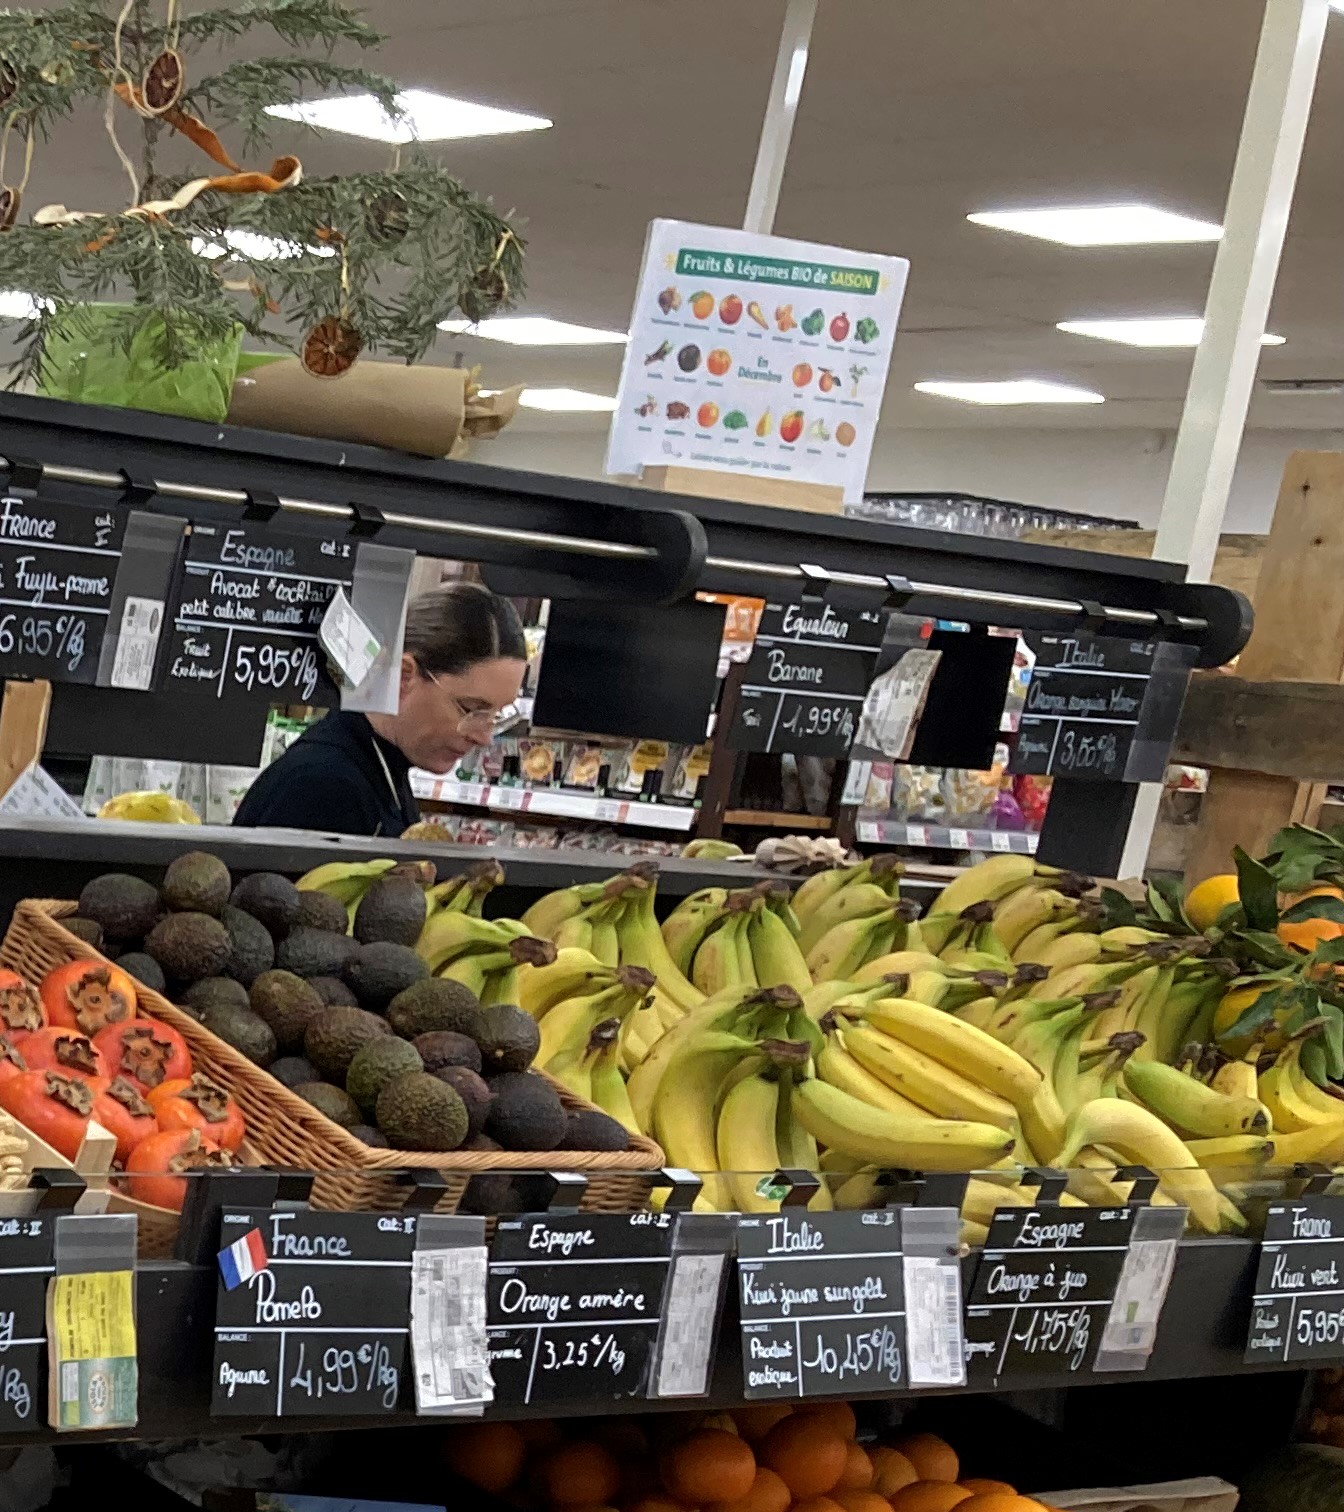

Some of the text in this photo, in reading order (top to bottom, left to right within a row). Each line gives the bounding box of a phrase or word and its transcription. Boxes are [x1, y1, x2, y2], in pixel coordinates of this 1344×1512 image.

[683, 254, 873, 289] Fruits & Légumes BIO de SAISON
[0, 498, 56, 539] France
[220, 530, 295, 570] Espagne
[211, 571, 260, 598] Avocat
[180, 598, 209, 620] petit
[768, 650, 823, 684] Banane
[269, 1213, 352, 1256] France
[529, 1223, 595, 1255] Espagne
[766, 1217, 824, 1254] Italie
[1013, 1212, 1084, 1250] Espagne
[1292, 1207, 1332, 1237] France
[987, 1265, 1040, 1302] Orange
[1043, 1263, 1055, 1287] à
[1270, 1253, 1339, 1289] Kiwi vert
[248, 1268, 322, 1324] Pomelo
[500, 1278, 645, 1320] Orange amère
[742, 1273, 776, 1305] Kiwi
[780, 1282, 819, 1315] jaune
